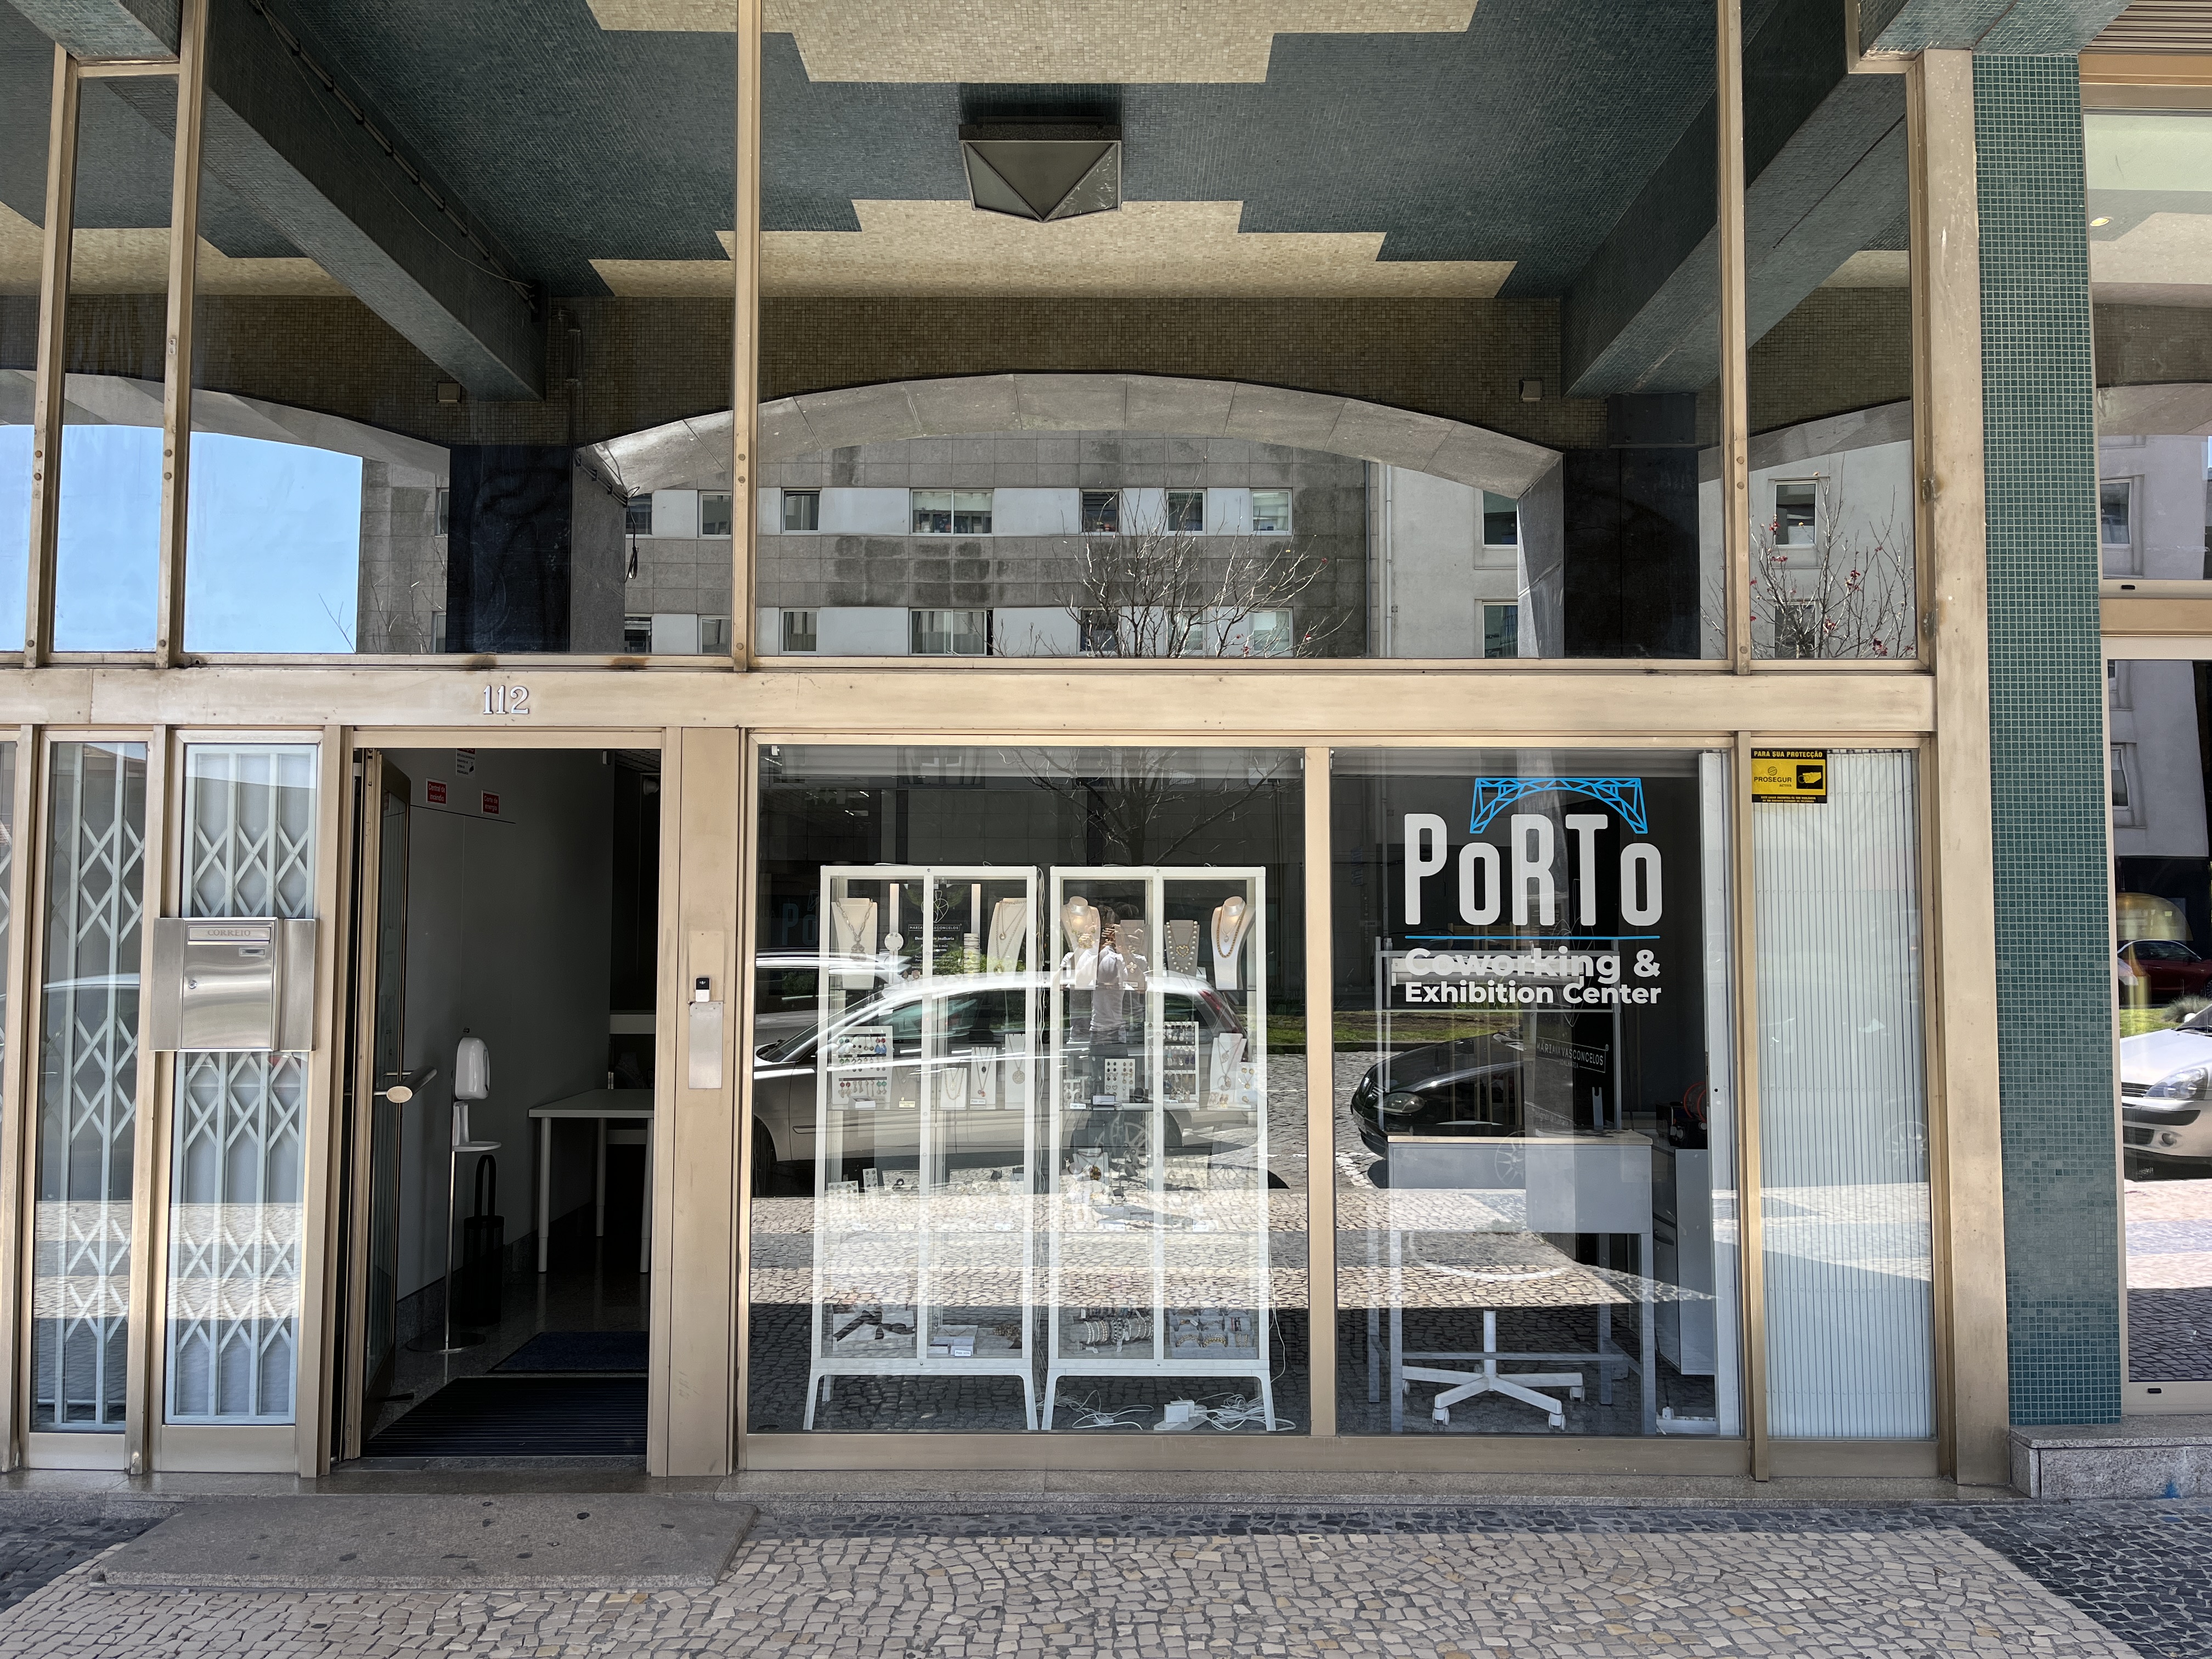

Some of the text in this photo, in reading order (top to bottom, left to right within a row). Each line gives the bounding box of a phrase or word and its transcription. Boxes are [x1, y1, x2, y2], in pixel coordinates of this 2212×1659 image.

[483, 685, 529, 715] 112
[1786, 750, 1823, 759] PROTECÇÃO
[1405, 945, 1661, 984] Coworking &
[1405, 980, 1662, 1004] Exhibition Center
[1537, 1042, 1604, 1065] MARIANA VASCONCELOS
